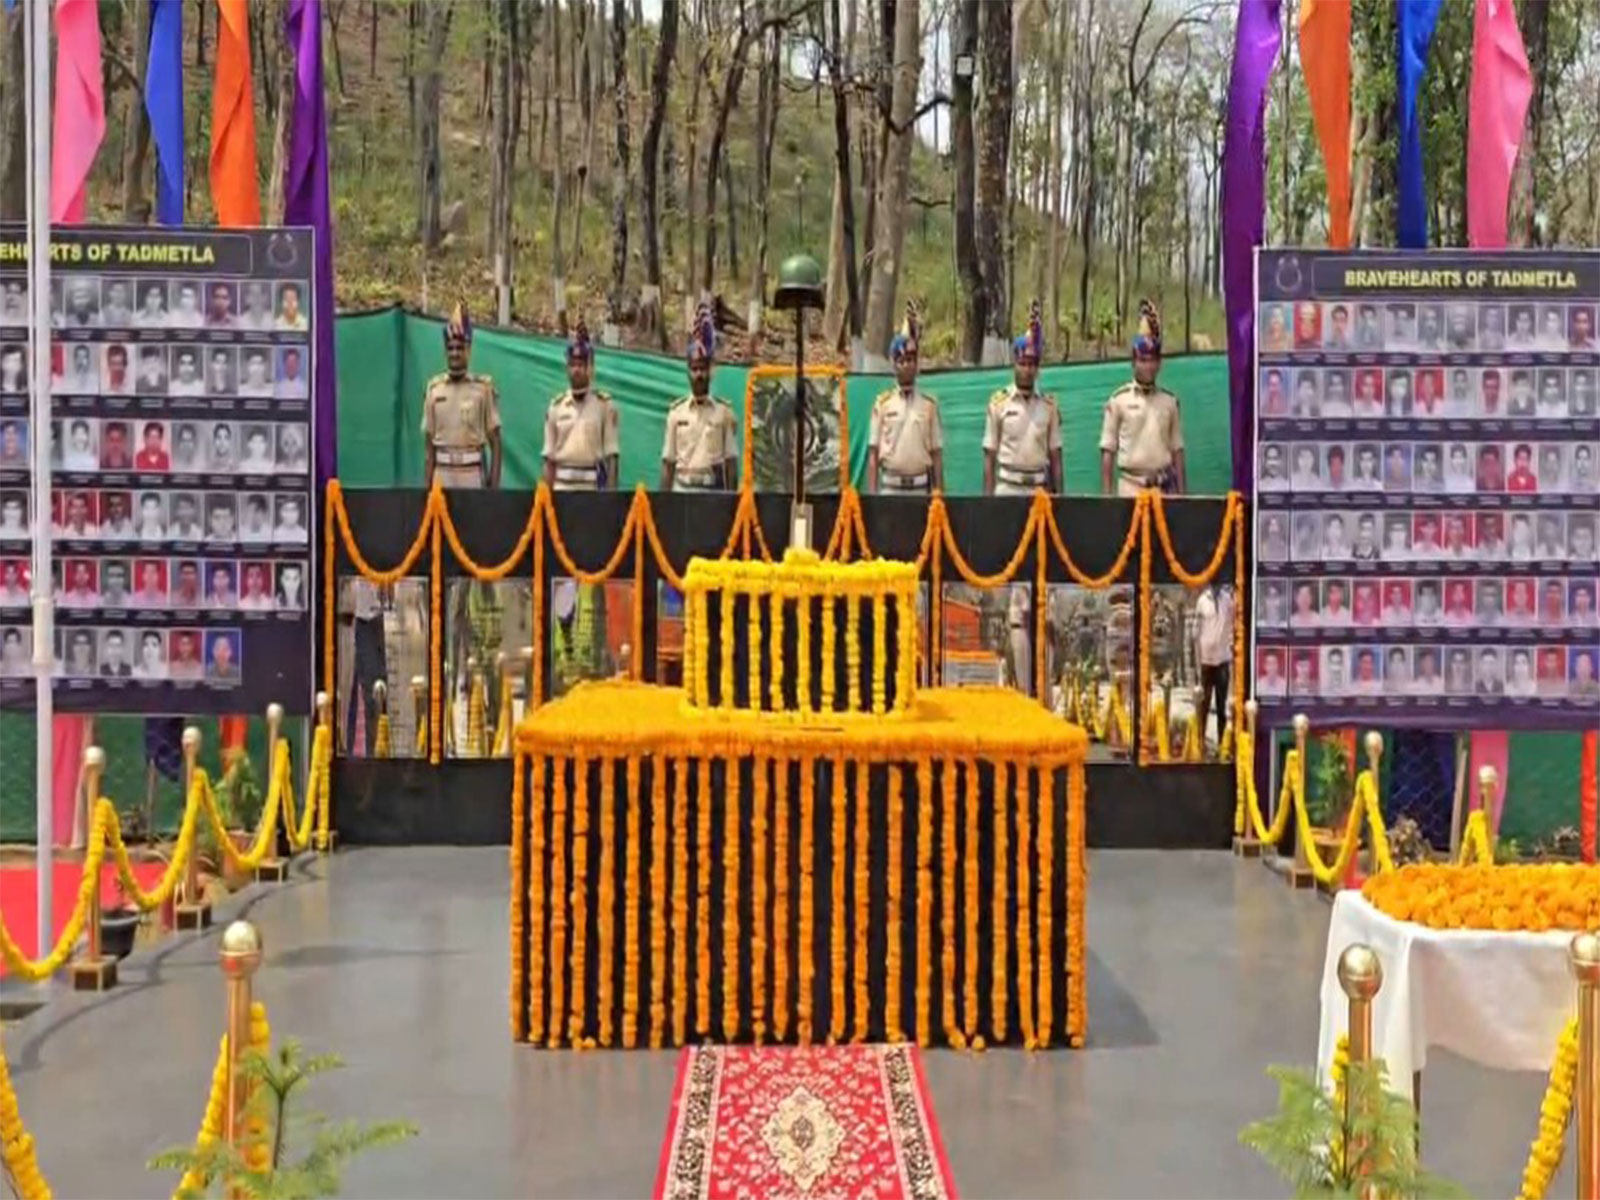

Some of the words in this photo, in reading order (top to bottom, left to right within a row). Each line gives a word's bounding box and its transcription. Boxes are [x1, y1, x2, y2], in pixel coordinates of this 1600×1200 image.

[87, 243, 111, 261] OF
[116, 243, 215, 264] TADMETLA
[1344, 269, 1462, 288] BRAVEHEARTS
[1465, 270, 1488, 288] OF
[1491, 269, 1578, 288] TADMETLA
